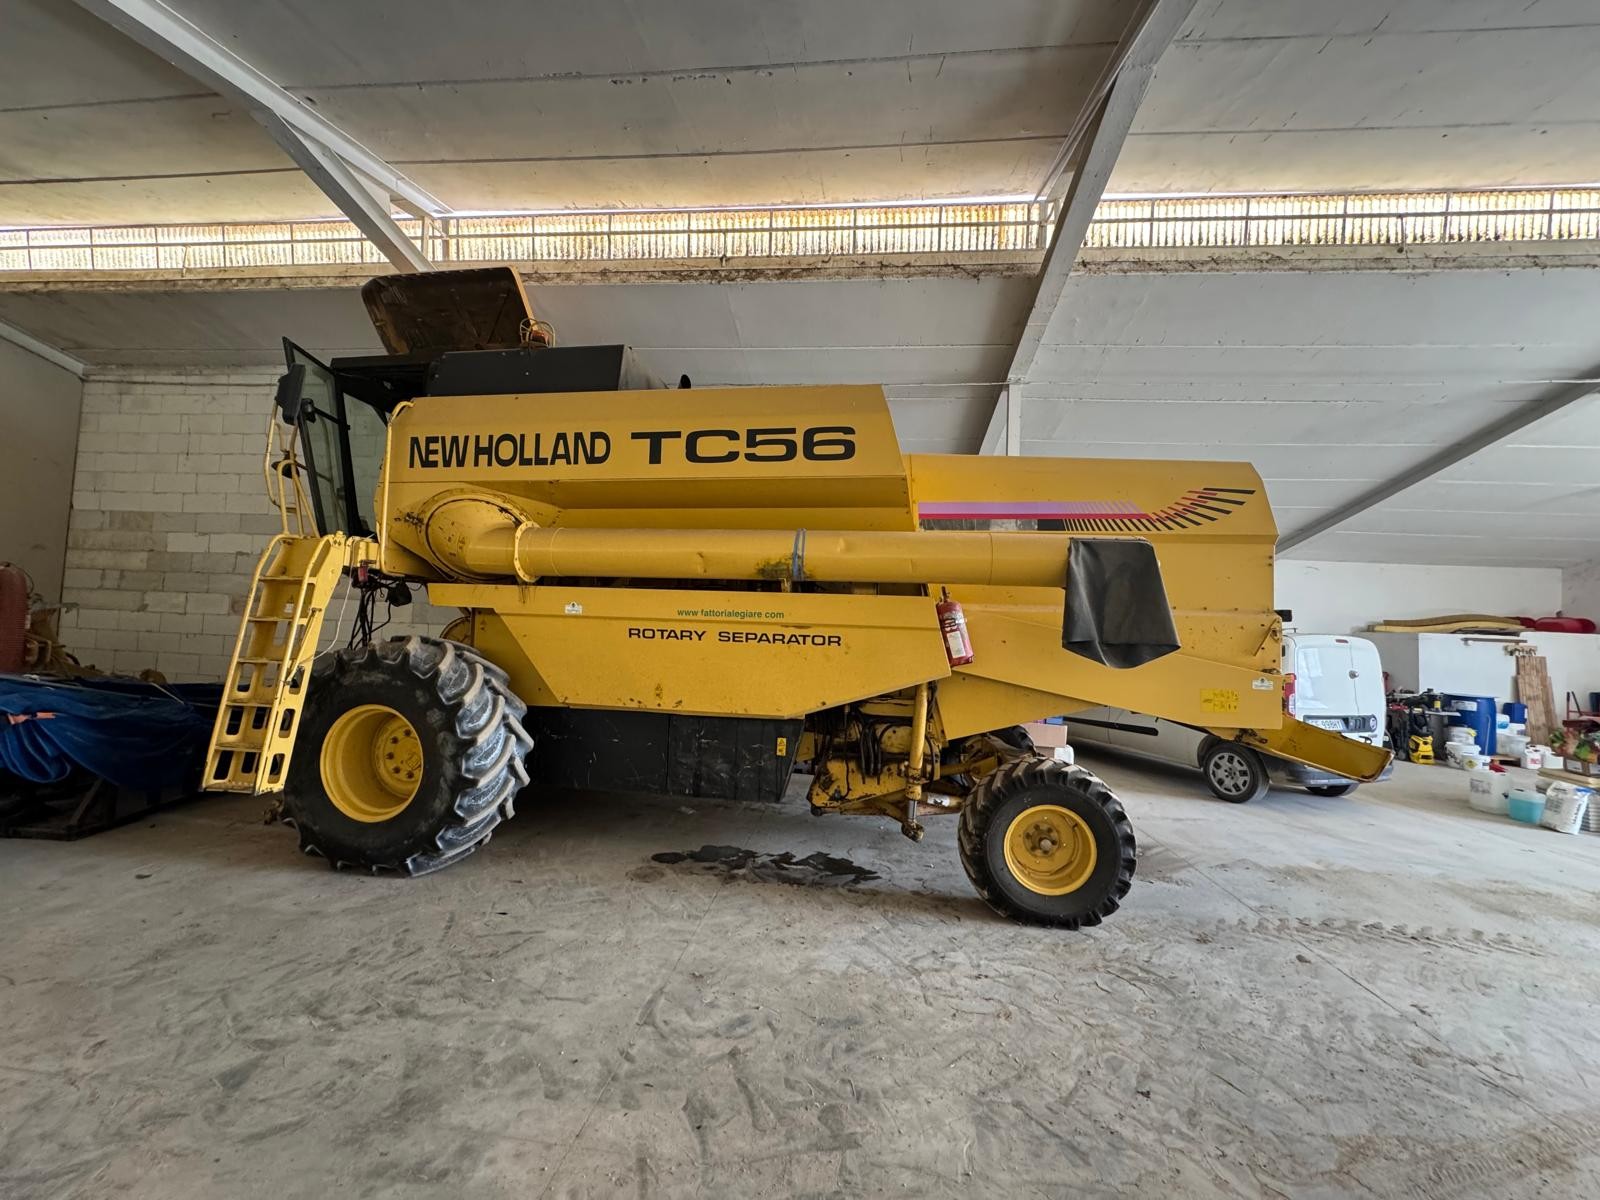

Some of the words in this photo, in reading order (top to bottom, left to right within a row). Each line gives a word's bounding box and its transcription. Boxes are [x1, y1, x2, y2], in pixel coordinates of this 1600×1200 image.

[409, 435, 470, 469] NEW
[473, 431, 611, 467] HOLLAND
[630, 426, 856, 465] TC56
[628, 628, 706, 642] ROTARY
[718, 631, 841, 647] SEPARATOR
